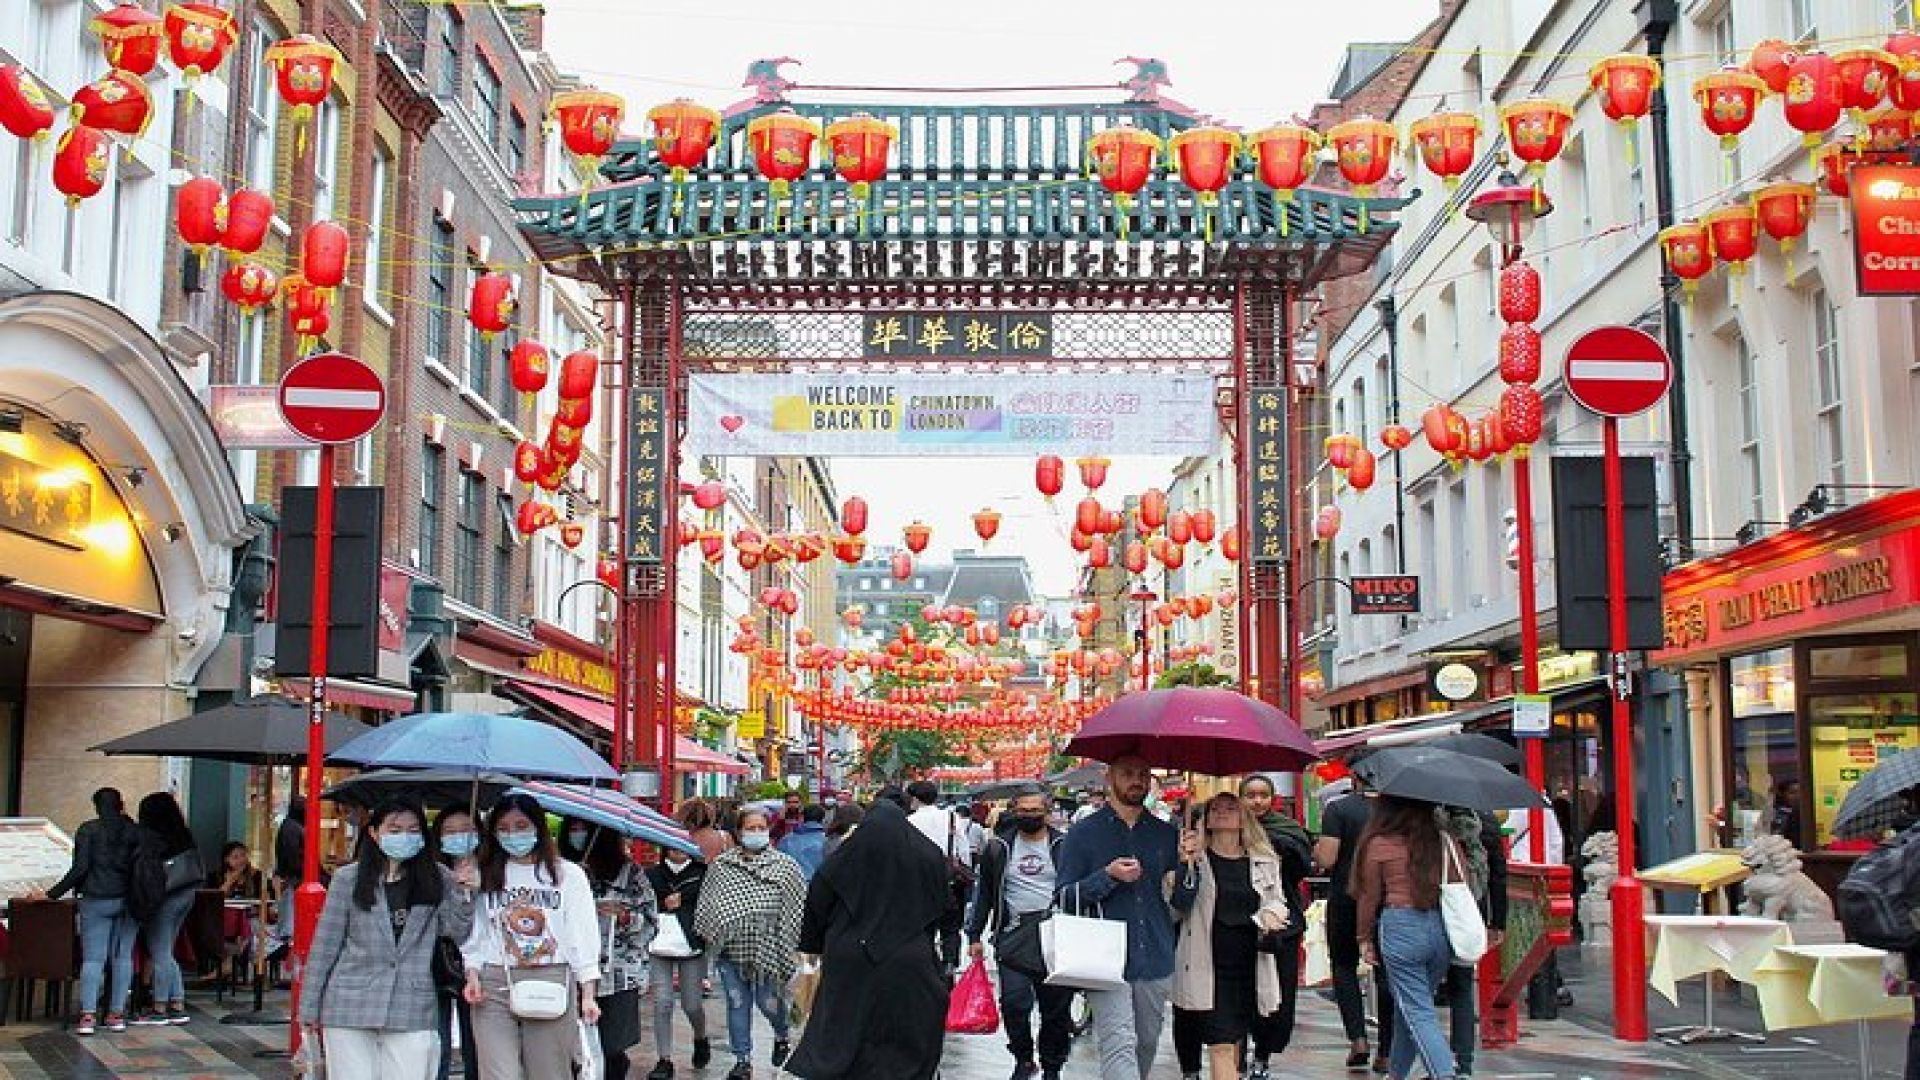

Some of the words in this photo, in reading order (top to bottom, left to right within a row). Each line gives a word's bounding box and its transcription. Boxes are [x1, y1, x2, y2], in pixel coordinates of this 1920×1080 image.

[807, 386, 895, 405] WELCOME
[910, 396, 994, 410] CHINATOWN
[814, 409, 863, 429] BACK
[870, 409, 892, 429] TO
[910, 414, 964, 429] LONDON
[1354, 579, 1416, 595] MIKO
